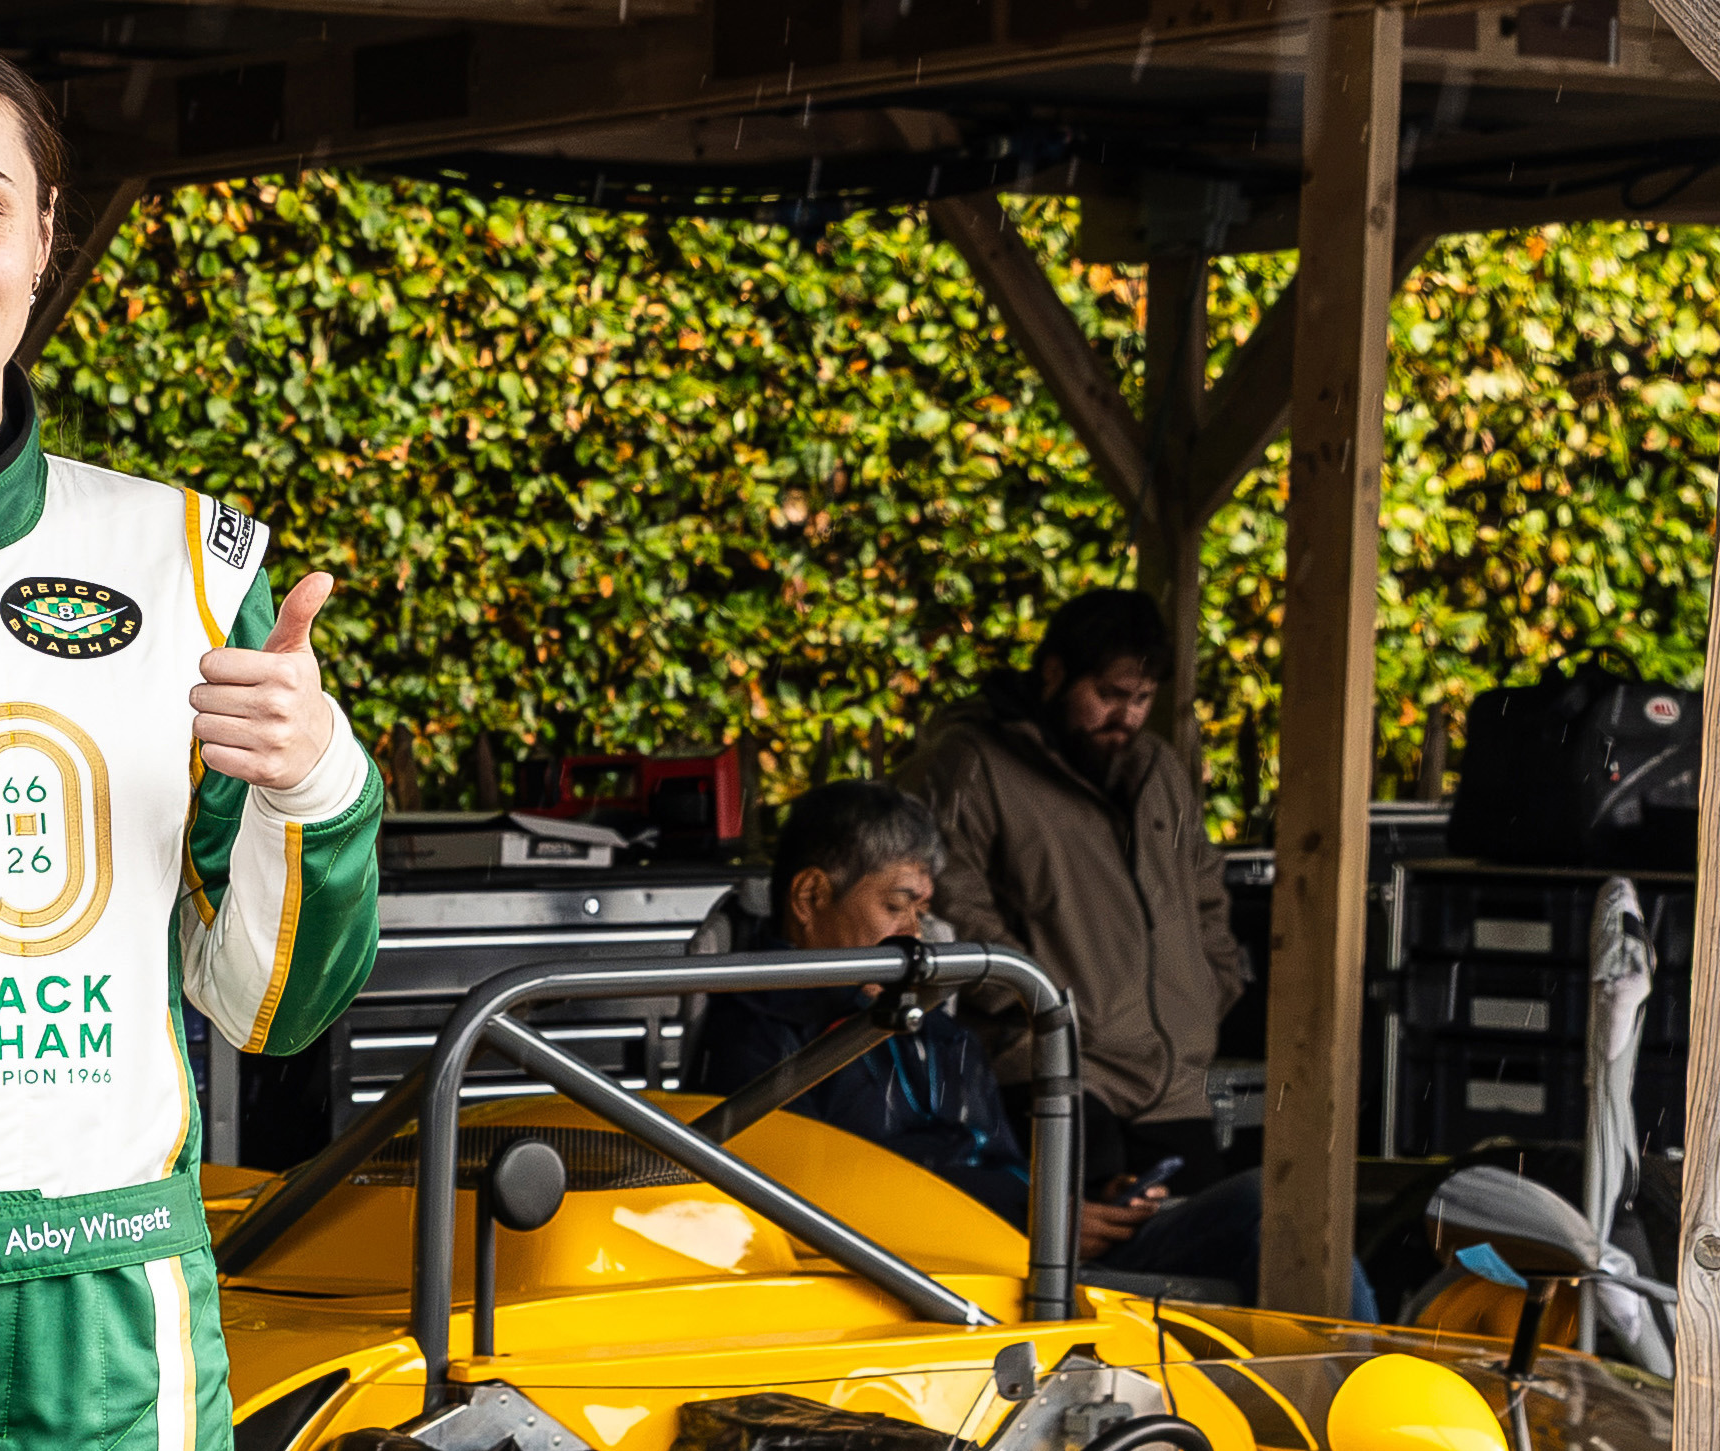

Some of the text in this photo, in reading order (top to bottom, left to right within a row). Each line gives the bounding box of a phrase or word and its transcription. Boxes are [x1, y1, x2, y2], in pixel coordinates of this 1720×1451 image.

[20, 583, 111, 602] REPCO
[8, 617, 136, 655] BRABHAM
[1, 776, 46, 802] 66
[7, 846, 52, 875] 26
[67, 1068, 112, 1085] 1966
[4, 1206, 172, 1256] Abby Wingett
